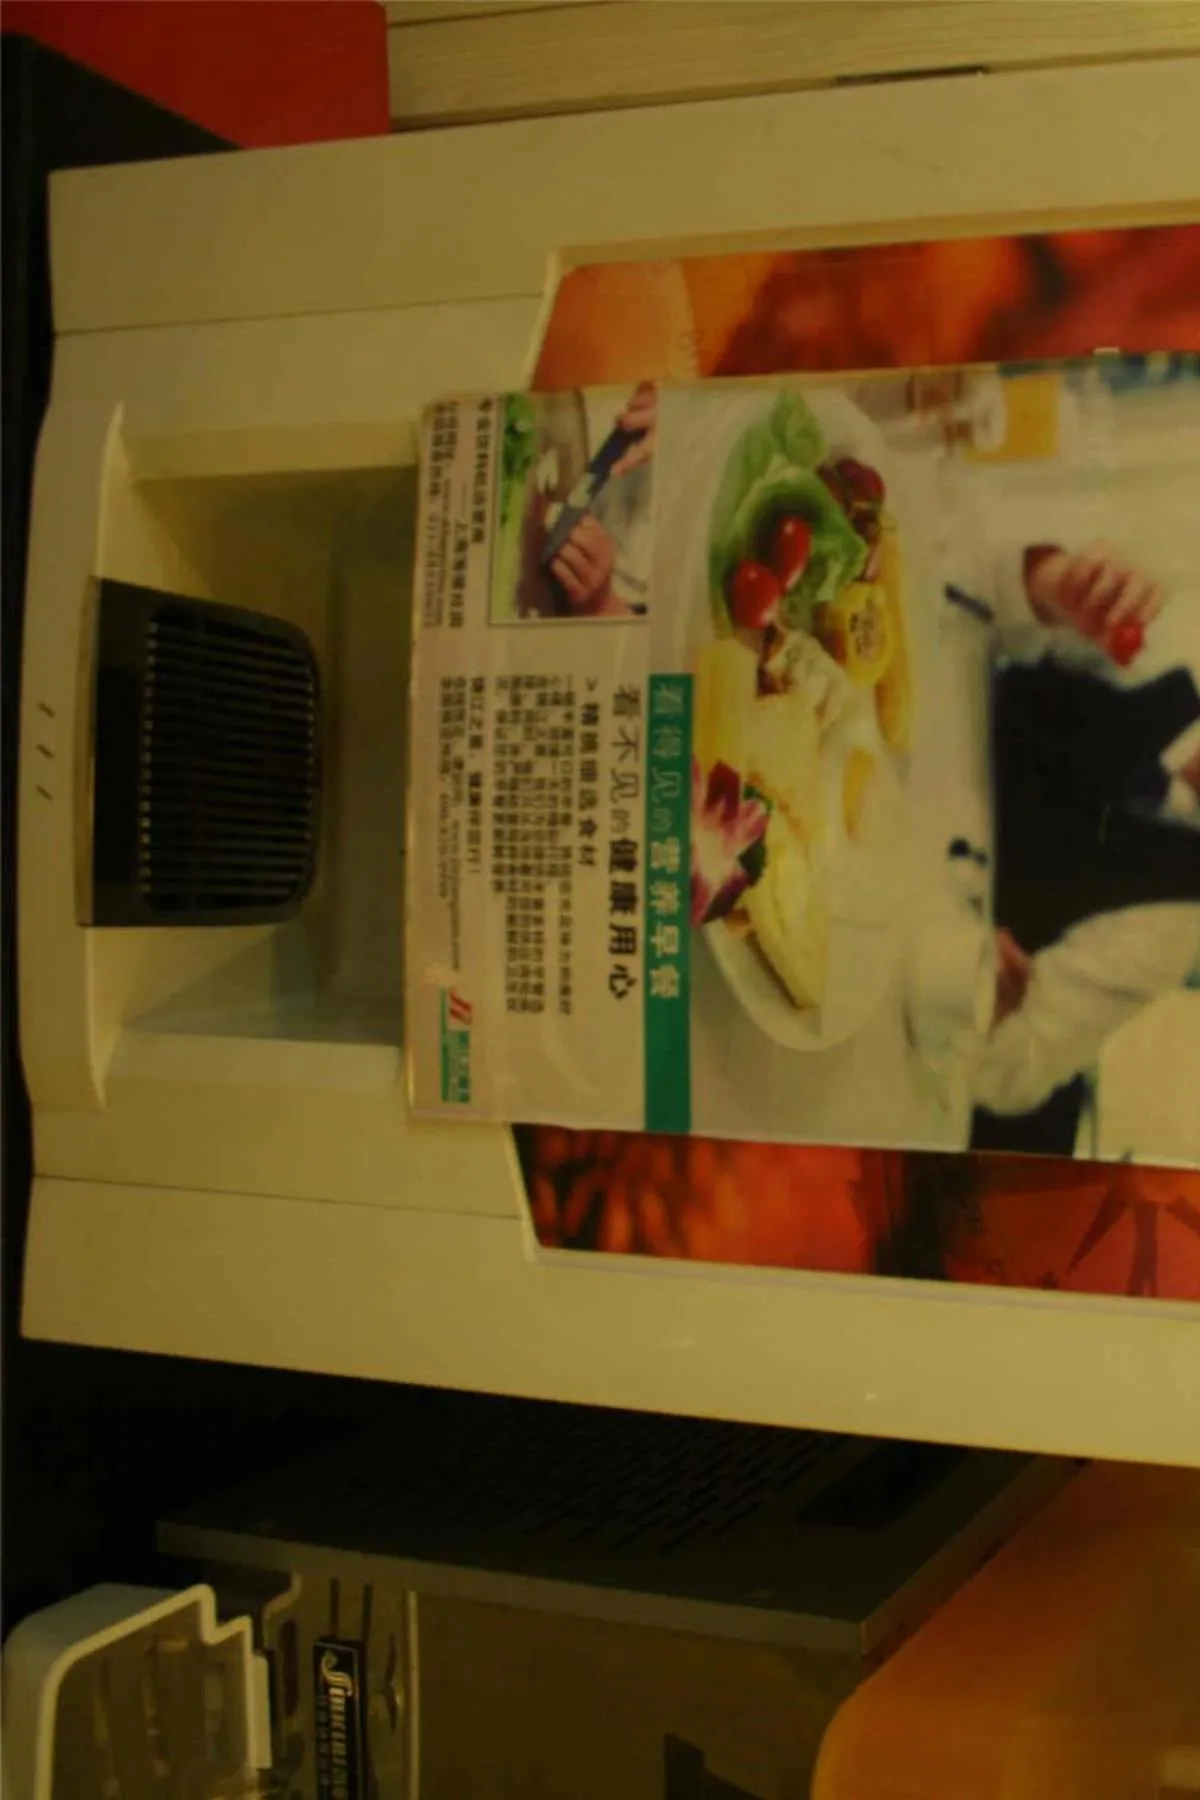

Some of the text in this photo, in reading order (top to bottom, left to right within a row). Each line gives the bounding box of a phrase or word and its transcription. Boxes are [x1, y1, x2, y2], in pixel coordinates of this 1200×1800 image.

[607, 684, 643, 1001] 看不见的健康用心
[648, 682, 686, 1001] 看得见的营养早餐
